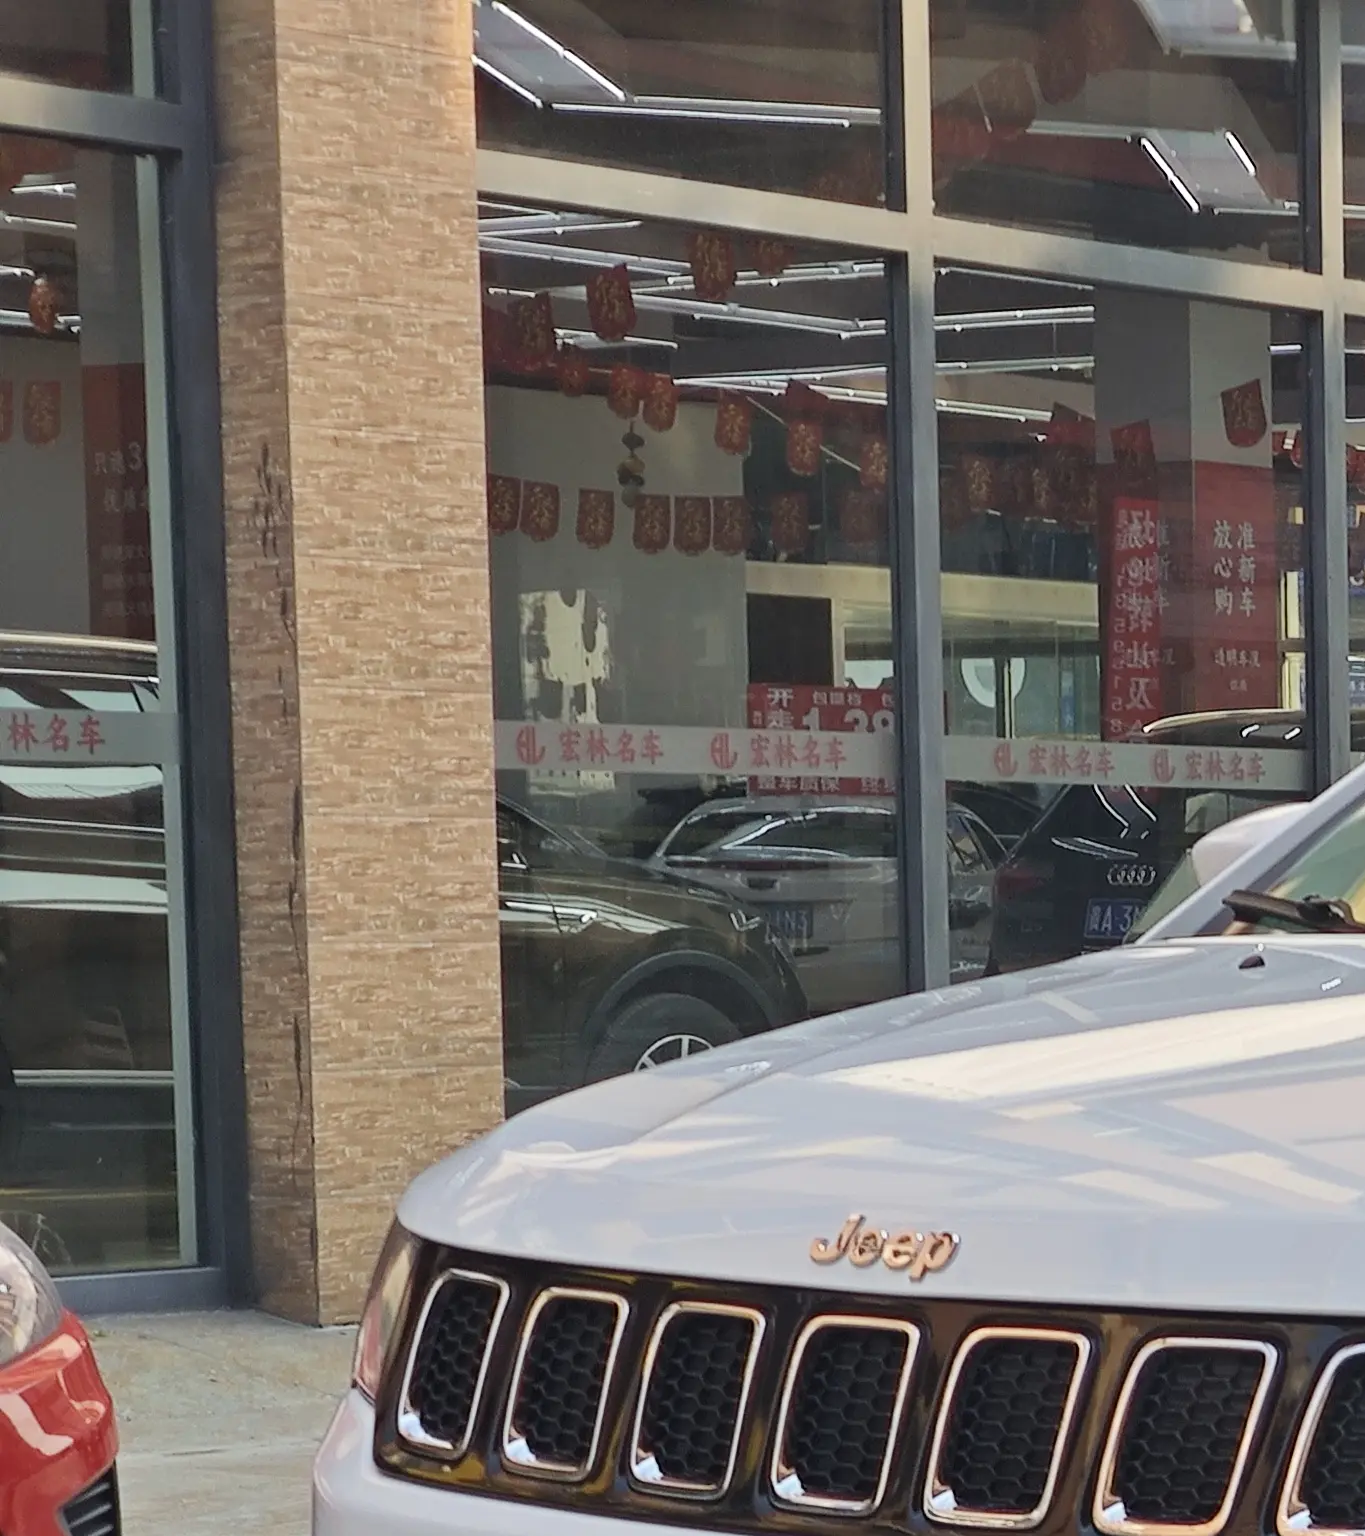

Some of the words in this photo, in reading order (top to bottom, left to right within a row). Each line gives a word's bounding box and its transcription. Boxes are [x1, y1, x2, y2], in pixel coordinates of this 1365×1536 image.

[0, 712, 105, 755] 林名车
[559, 729, 664, 765] 宏林名车
[751, 733, 846, 770] 宏林名车
[1028, 744, 1115, 777] 宏林名车
[1186, 750, 1266, 783] 宏林名车
[809, 1214, 961, 1283] Jeep
